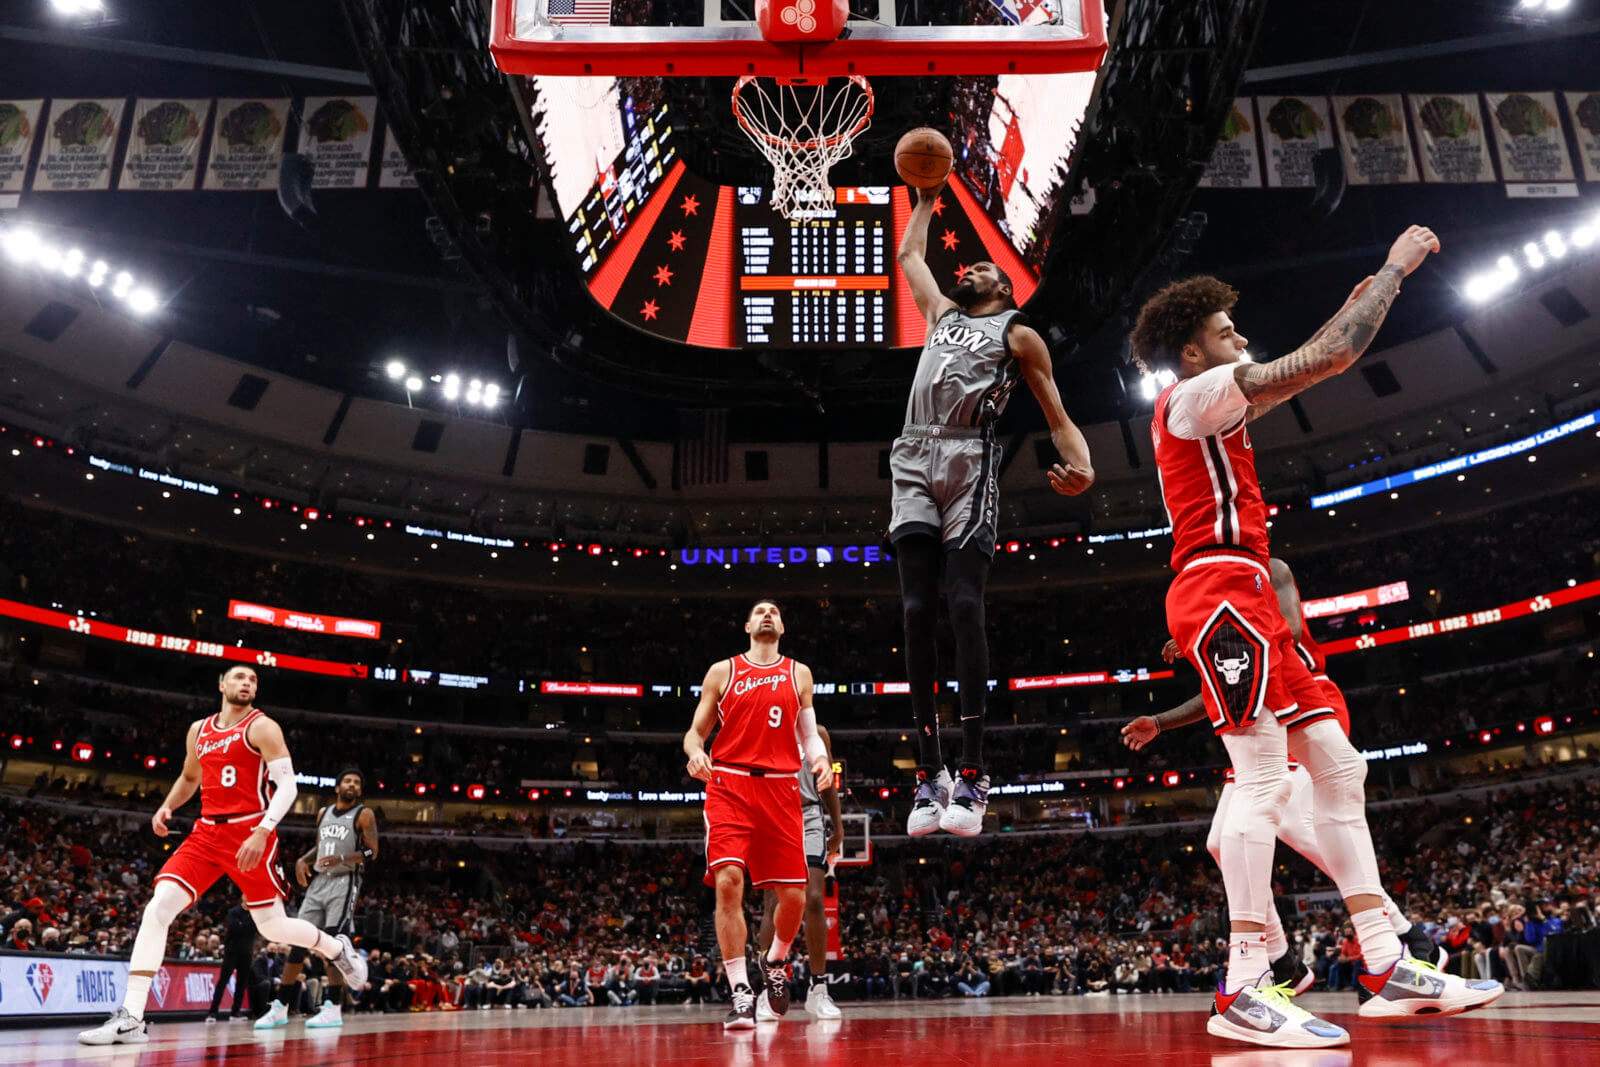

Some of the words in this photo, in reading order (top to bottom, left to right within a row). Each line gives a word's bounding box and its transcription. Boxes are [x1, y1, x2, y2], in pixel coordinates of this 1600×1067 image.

[928, 325, 993, 353] BKLYN
[932, 352, 954, 384] 7
[681, 547, 808, 564] UNITED
[1439, 615, 1468, 632] 1992
[161, 635, 191, 652] 1997
[734, 674, 788, 695] Chicago
[768, 705, 783, 728] 9
[196, 732, 241, 759] Chicago
[221, 765, 237, 788] 8
[638, 790, 658, 801] Love
[658, 790, 683, 801] where
[684, 792, 700, 803] you
[76, 969, 117, 1003] #NBA75
[184, 972, 216, 1003] #NBA75
